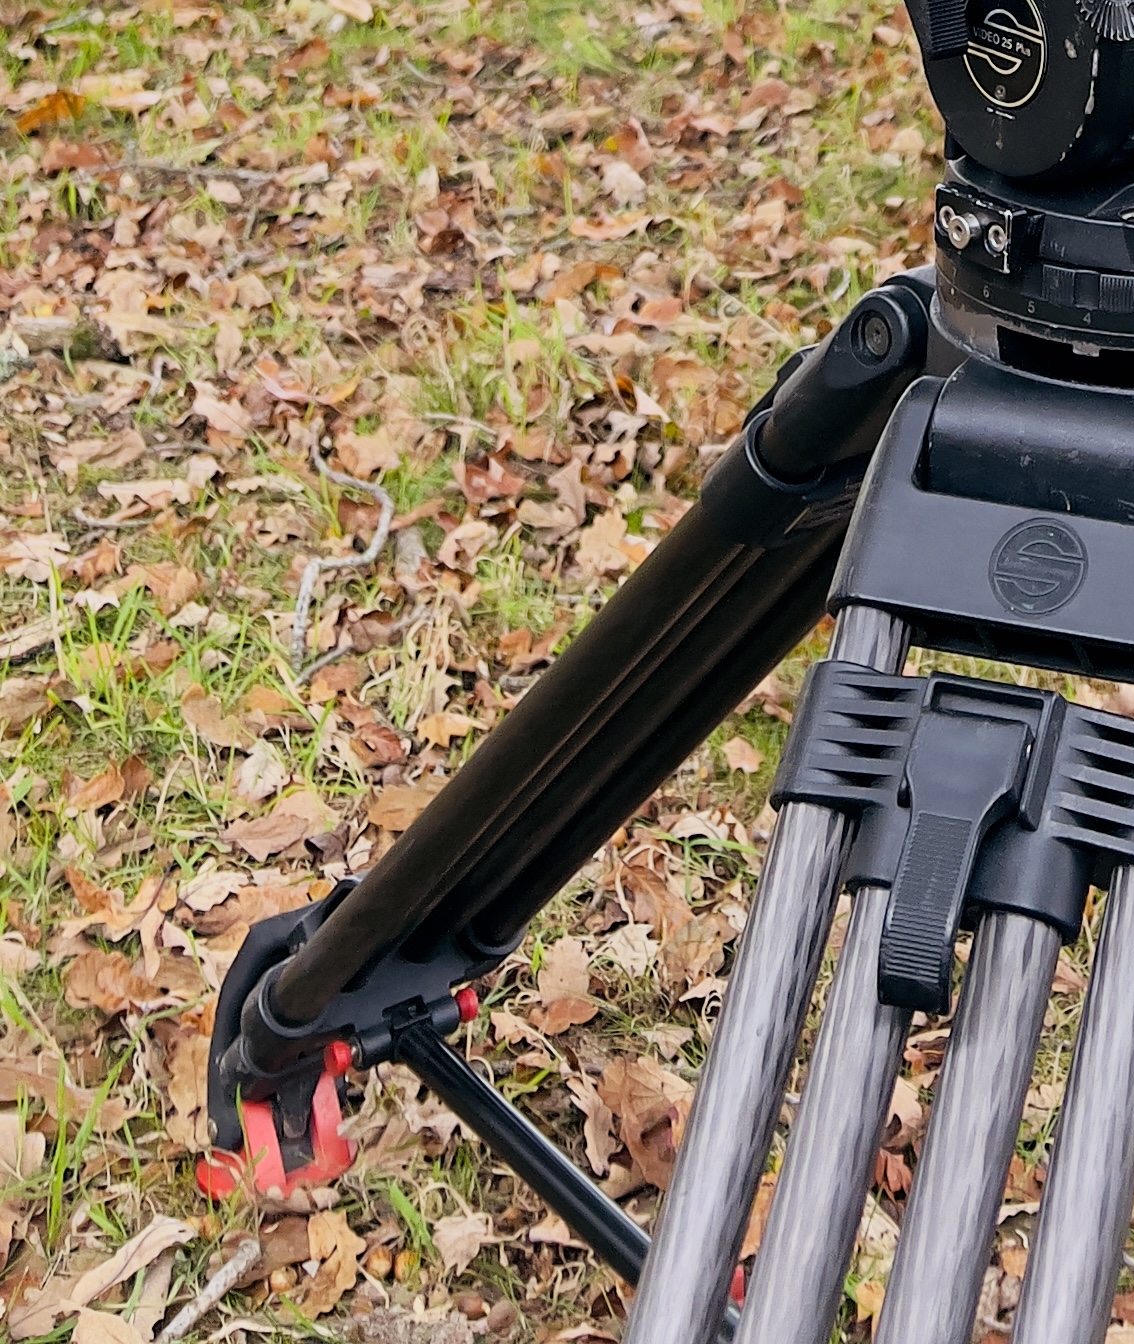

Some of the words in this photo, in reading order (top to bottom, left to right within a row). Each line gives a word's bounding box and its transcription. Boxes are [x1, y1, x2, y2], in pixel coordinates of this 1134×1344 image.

[973, 26, 1000, 45] VIDEO
[1001, 37, 1013, 50] 25
[983, 285, 990, 298] 6
[1027, 300, 1036, 314] 5
[1082, 313, 1091, 326] 4
